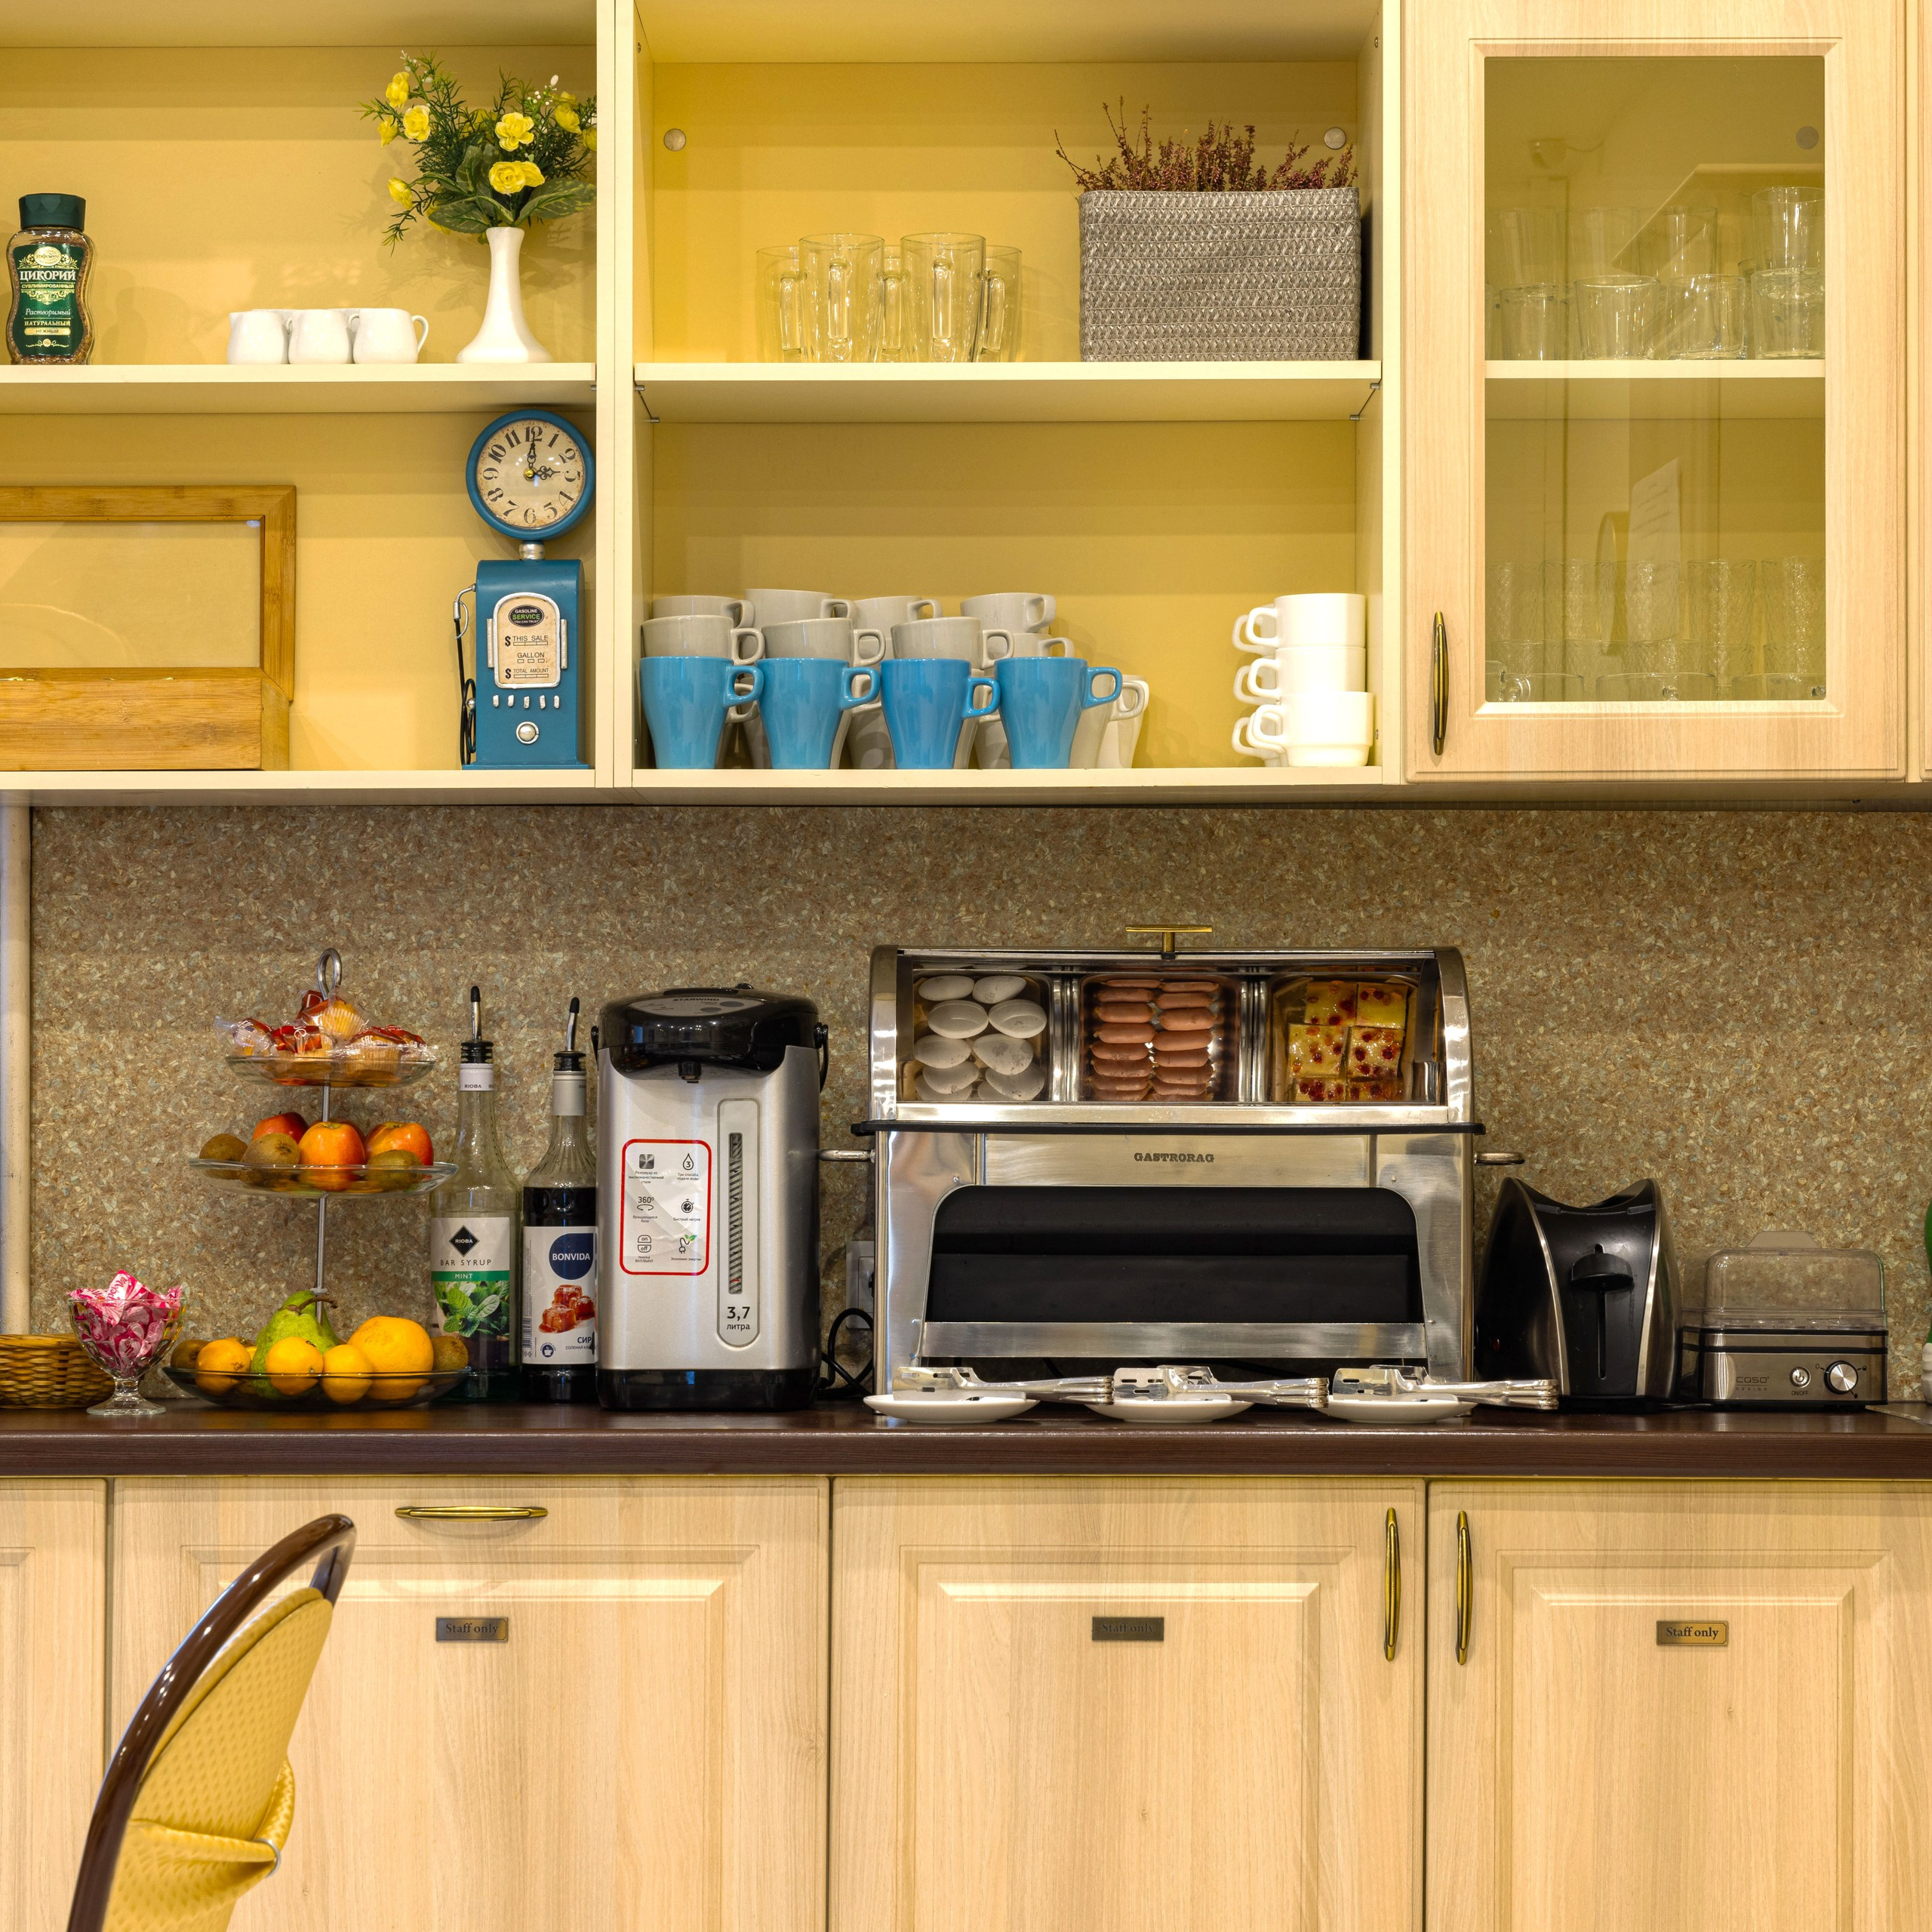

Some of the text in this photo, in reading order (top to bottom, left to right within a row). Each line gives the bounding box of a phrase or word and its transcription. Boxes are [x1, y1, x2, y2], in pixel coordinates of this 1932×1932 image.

[20, 269, 76, 281] ЦИКОРИЙ
[505, 429, 521, 448] 11
[525, 426, 543, 442] 12
[548, 433, 560, 448] 1
[488, 444, 506, 464] 10
[558, 448, 576, 463] 2
[482, 467, 499, 481] 9
[564, 469, 581, 482] 3
[488, 488, 503, 502] 8
[558, 491, 574, 506] 4
[503, 500, 519, 517] 7
[543, 502, 558, 519] 5
[523, 508, 536, 525] 6
[1134, 1152, 1214, 1163] GASTRORAG
[552, 1253, 591, 1261] BONVIDA
[727, 1306, 750, 1321] 3,7
[445, 1623, 499, 1636] Staff only
[1102, 1623, 1155, 1635] Staff only
[1666, 1626, 1719, 1640] Staff only
